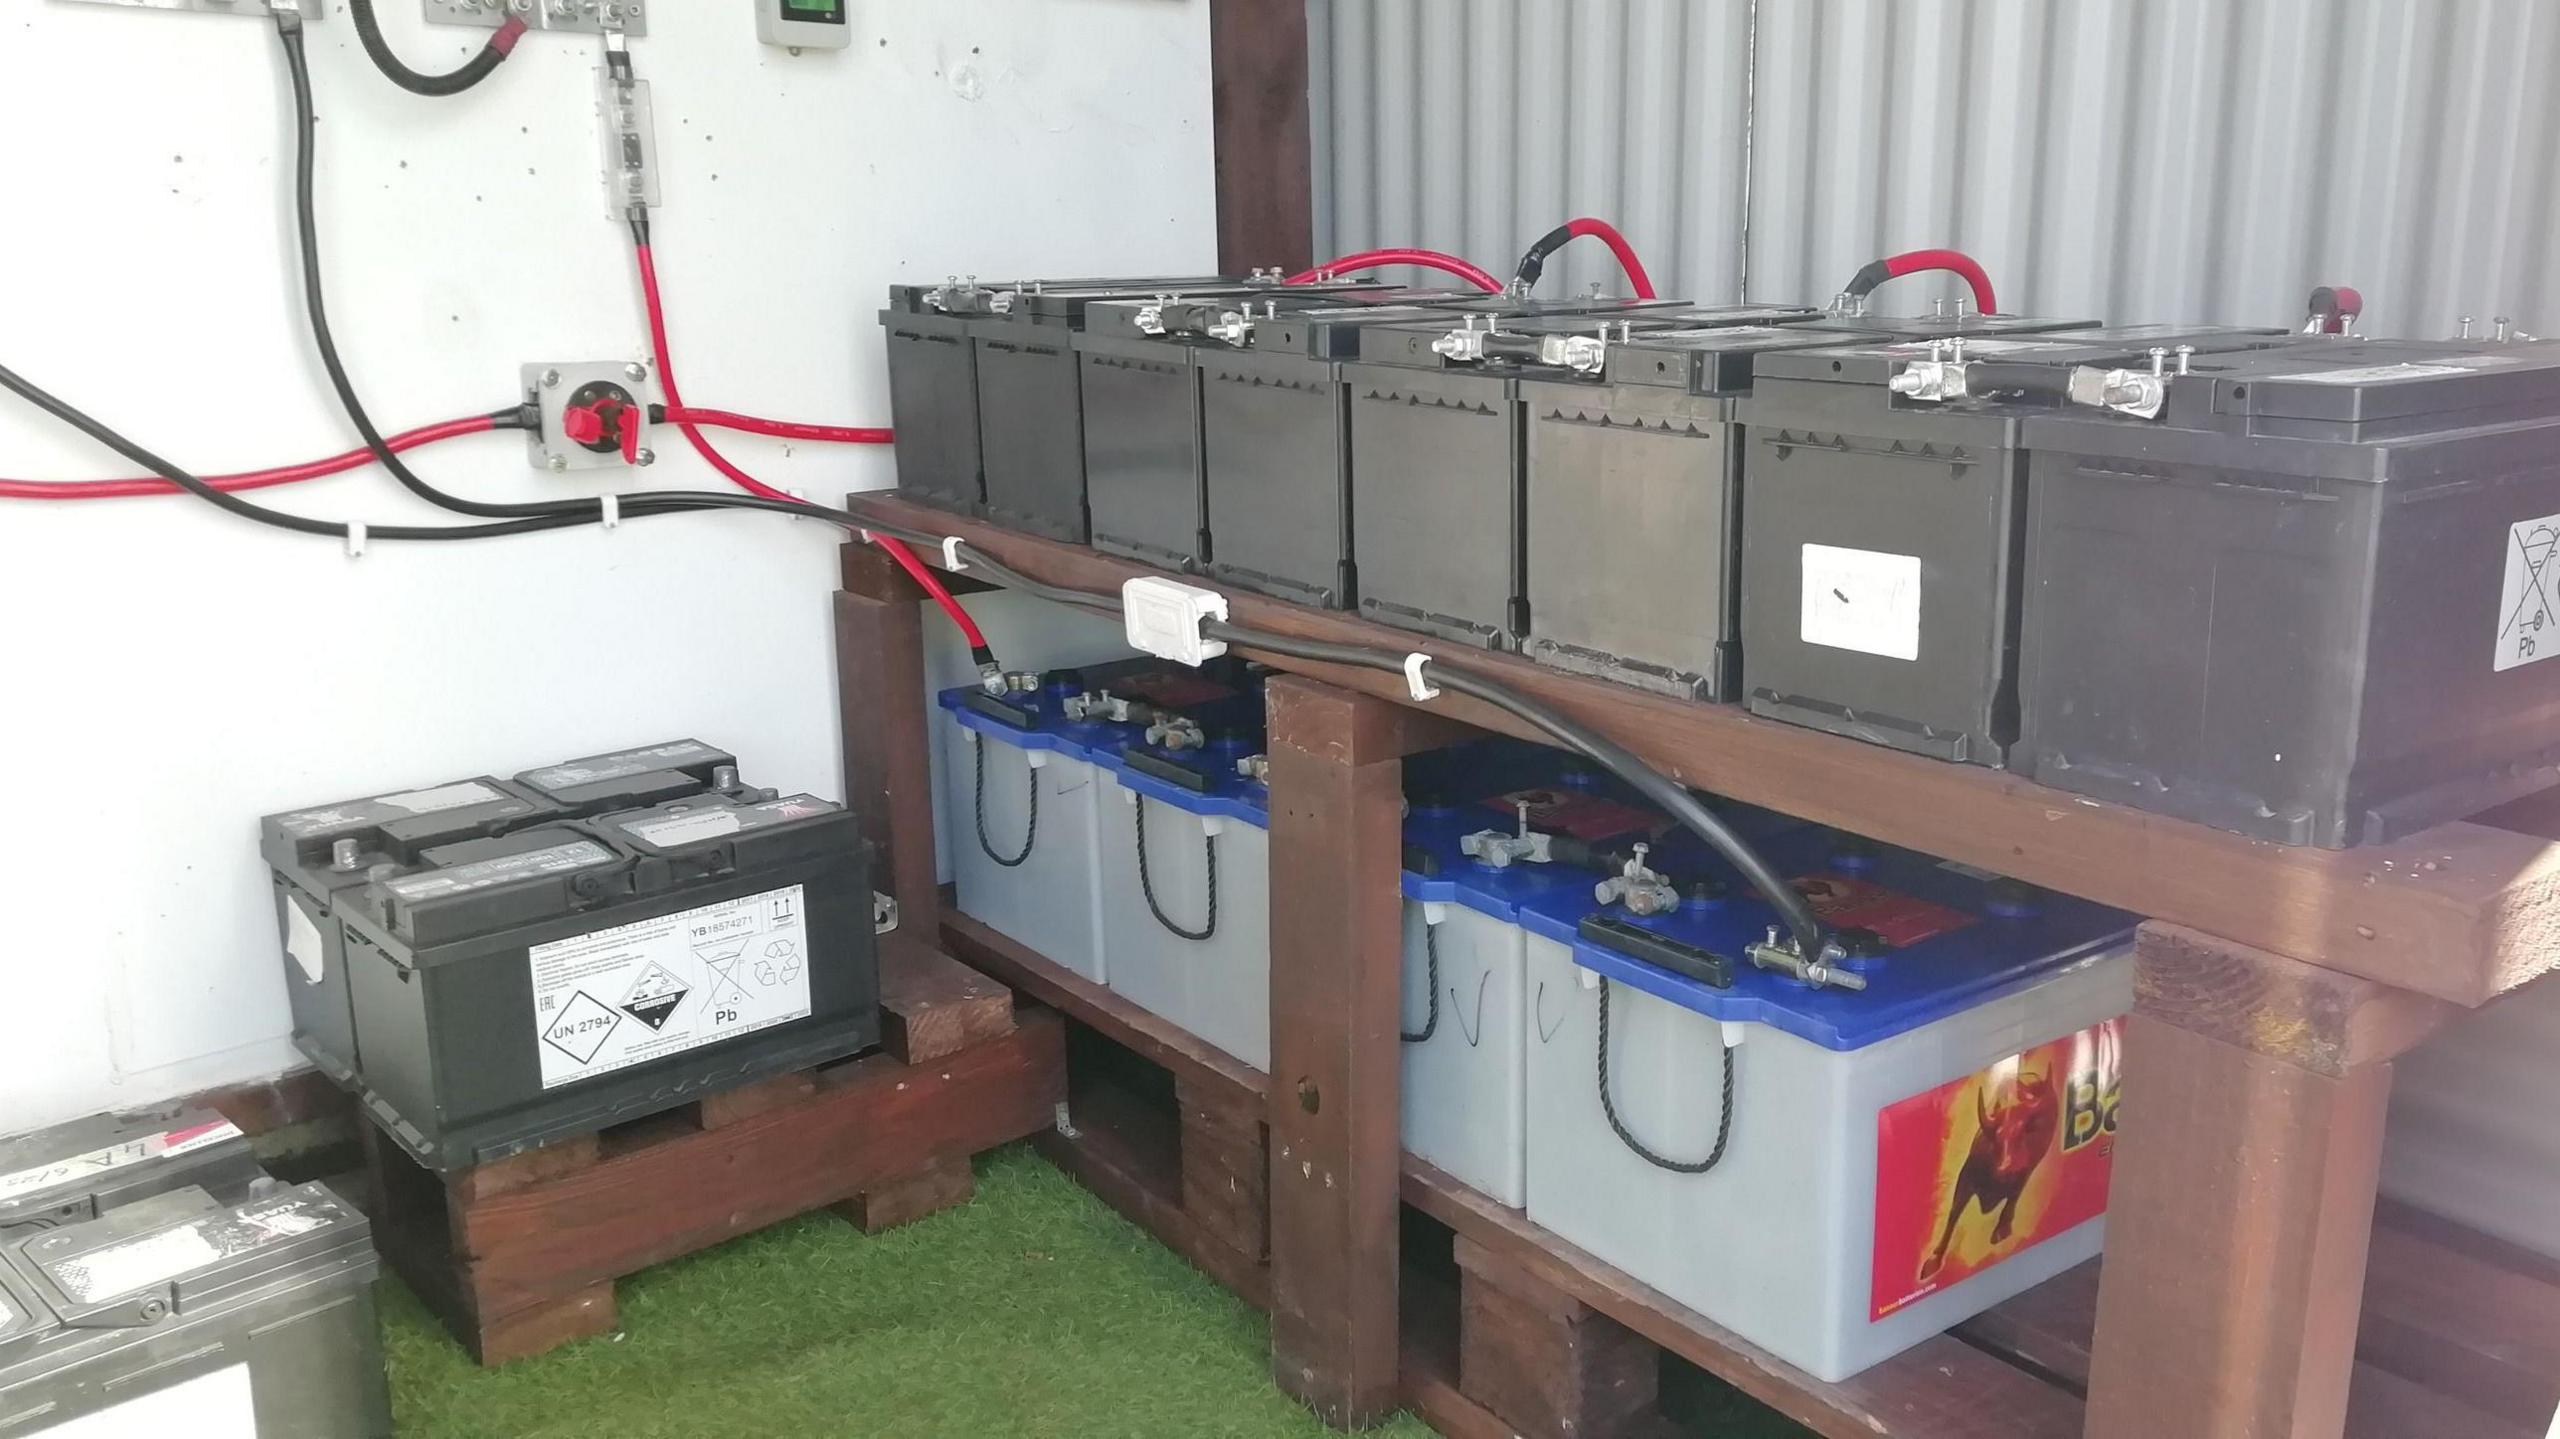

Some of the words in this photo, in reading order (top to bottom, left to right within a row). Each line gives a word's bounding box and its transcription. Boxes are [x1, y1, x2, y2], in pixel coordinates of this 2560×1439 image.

[2518, 635, 2536, 659] Pb
[633, 993, 676, 1012] CORROSIVE
[553, 1024, 574, 1039] UN
[579, 1015, 612, 1033] 2794
[715, 1008, 738, 1025] Pb
